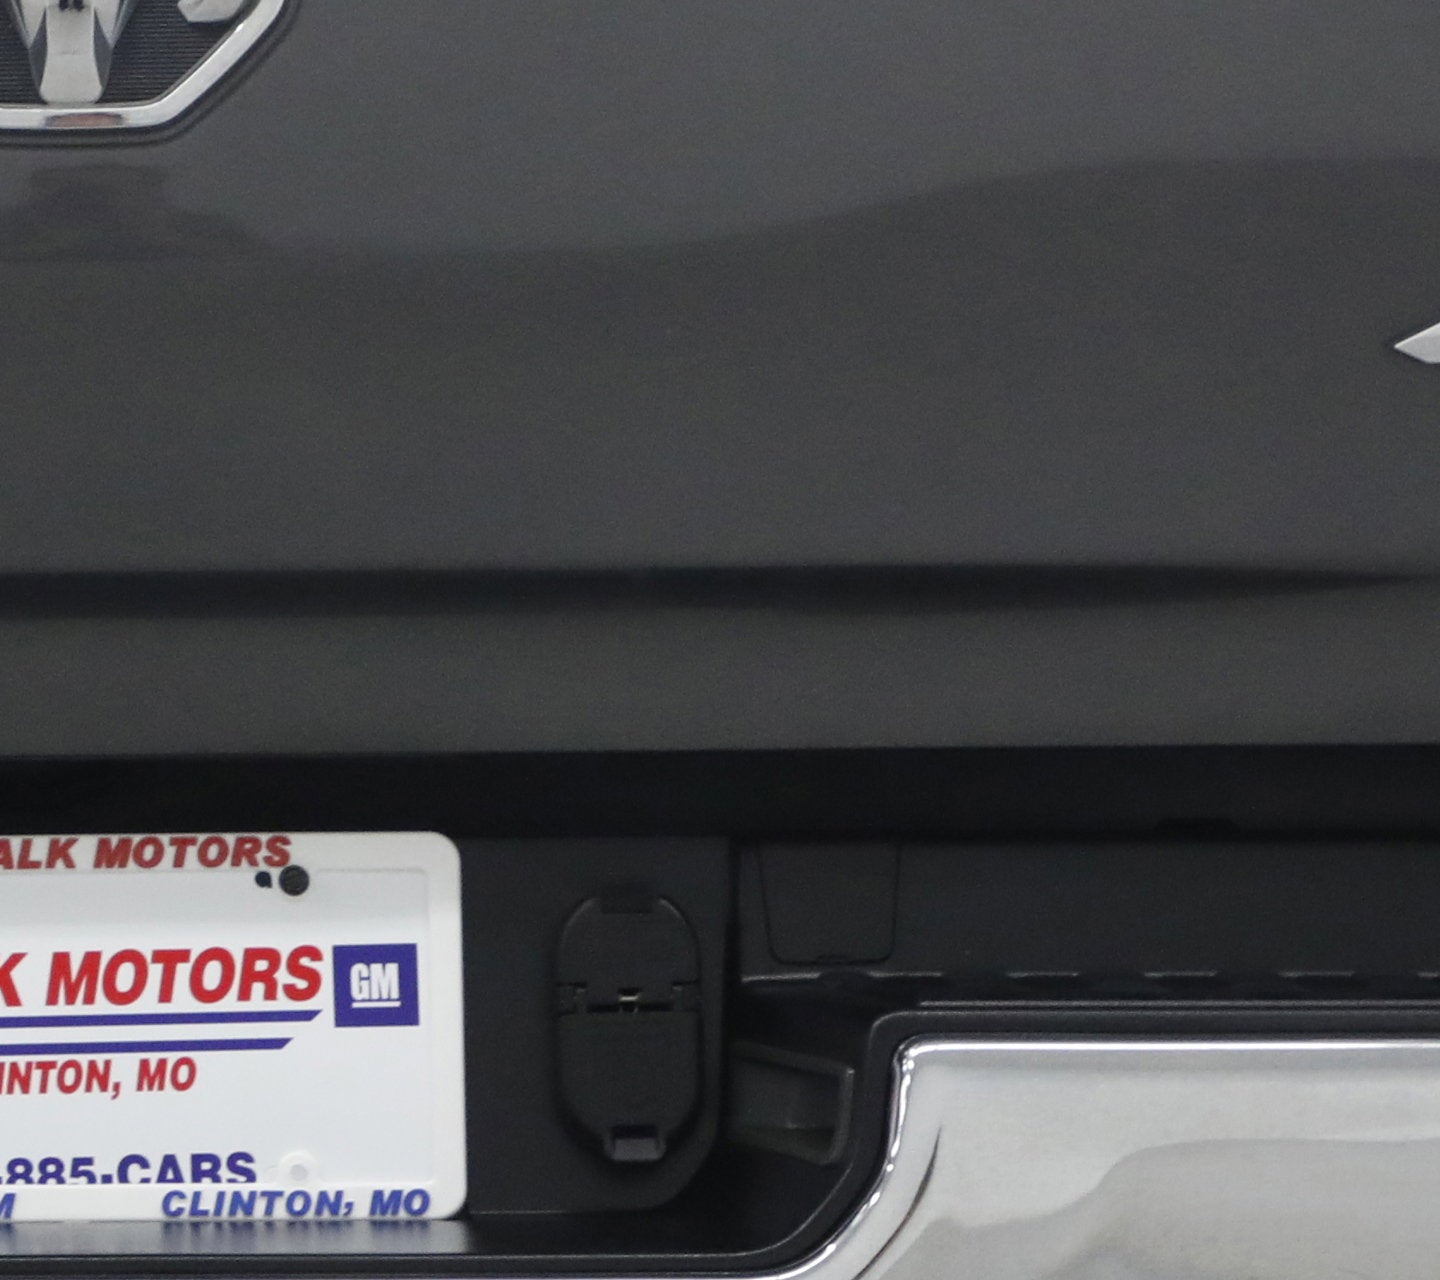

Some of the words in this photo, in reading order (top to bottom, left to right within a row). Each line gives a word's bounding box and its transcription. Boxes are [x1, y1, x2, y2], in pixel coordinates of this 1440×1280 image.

[94, 835, 292, 869] MOTORS
[46, 944, 324, 1007] MOTORS
[350, 962, 400, 1001] GM
[135, 1056, 198, 1092] MO
[161, 1190, 353, 1219] CLINTON,
[369, 1188, 431, 1217] MO
